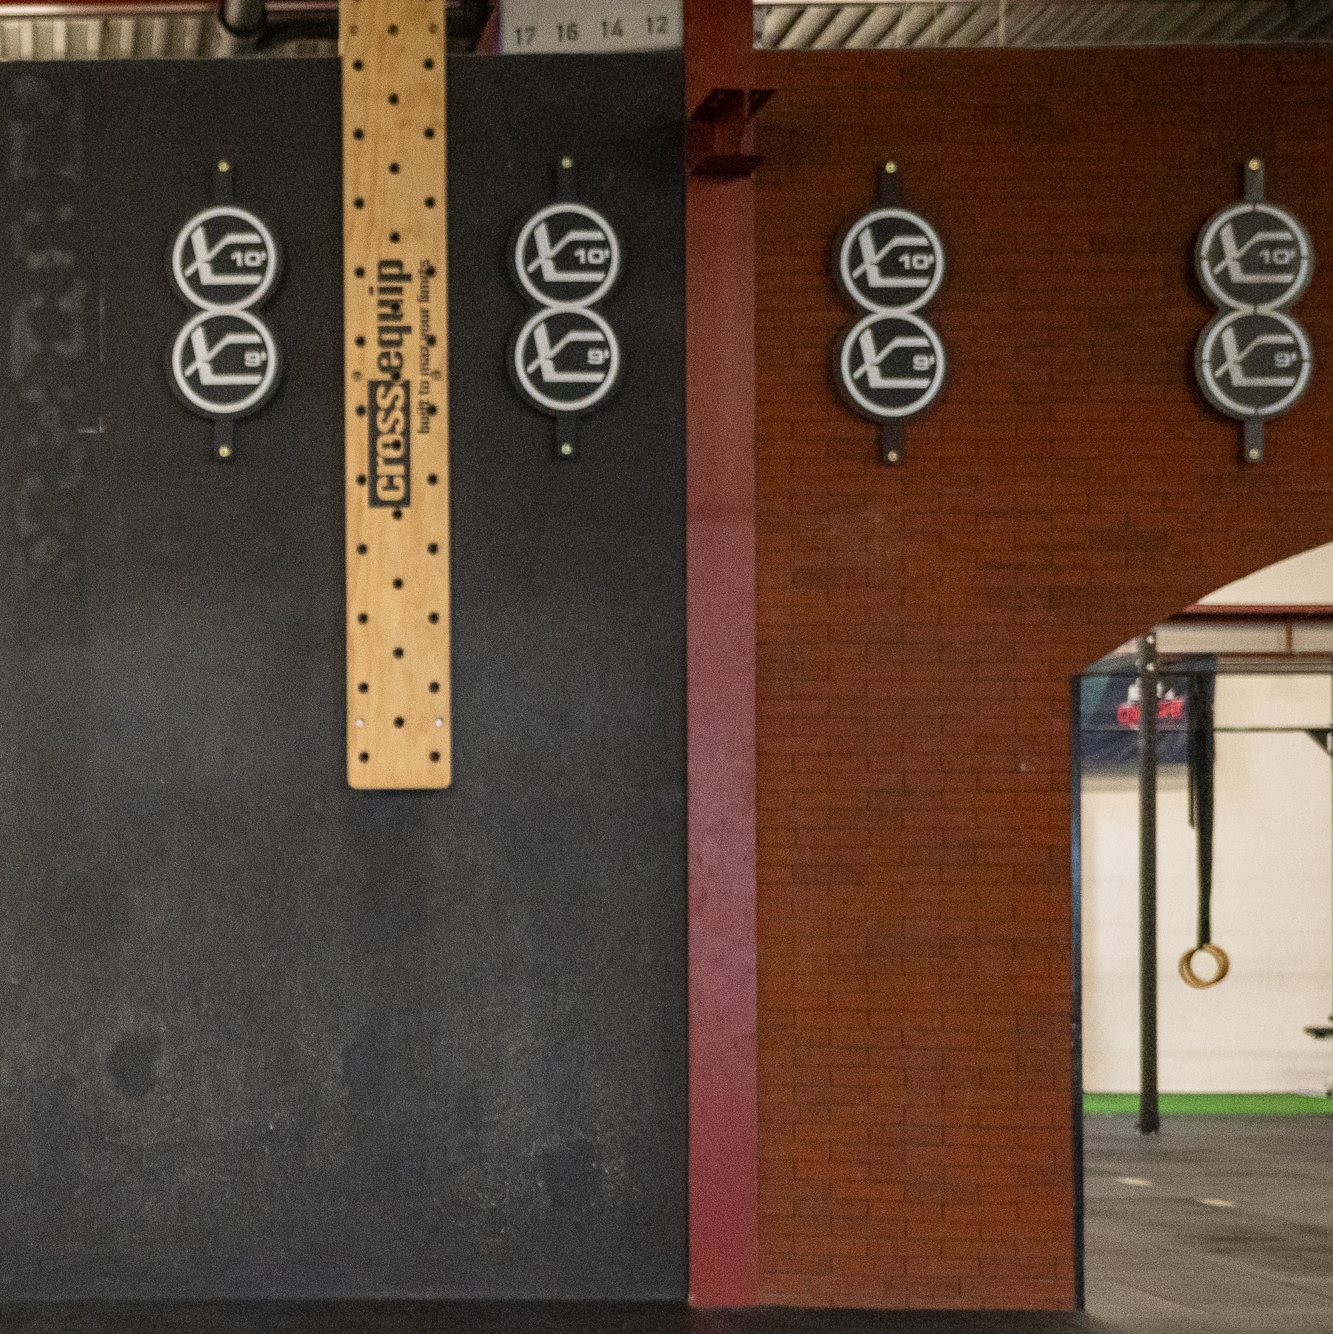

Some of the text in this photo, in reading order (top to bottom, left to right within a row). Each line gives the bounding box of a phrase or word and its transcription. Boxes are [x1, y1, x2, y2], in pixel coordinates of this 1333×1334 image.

[556, 22, 579, 43] 16
[601, 18, 624, 39] 14
[646, 15, 669, 36] 12
